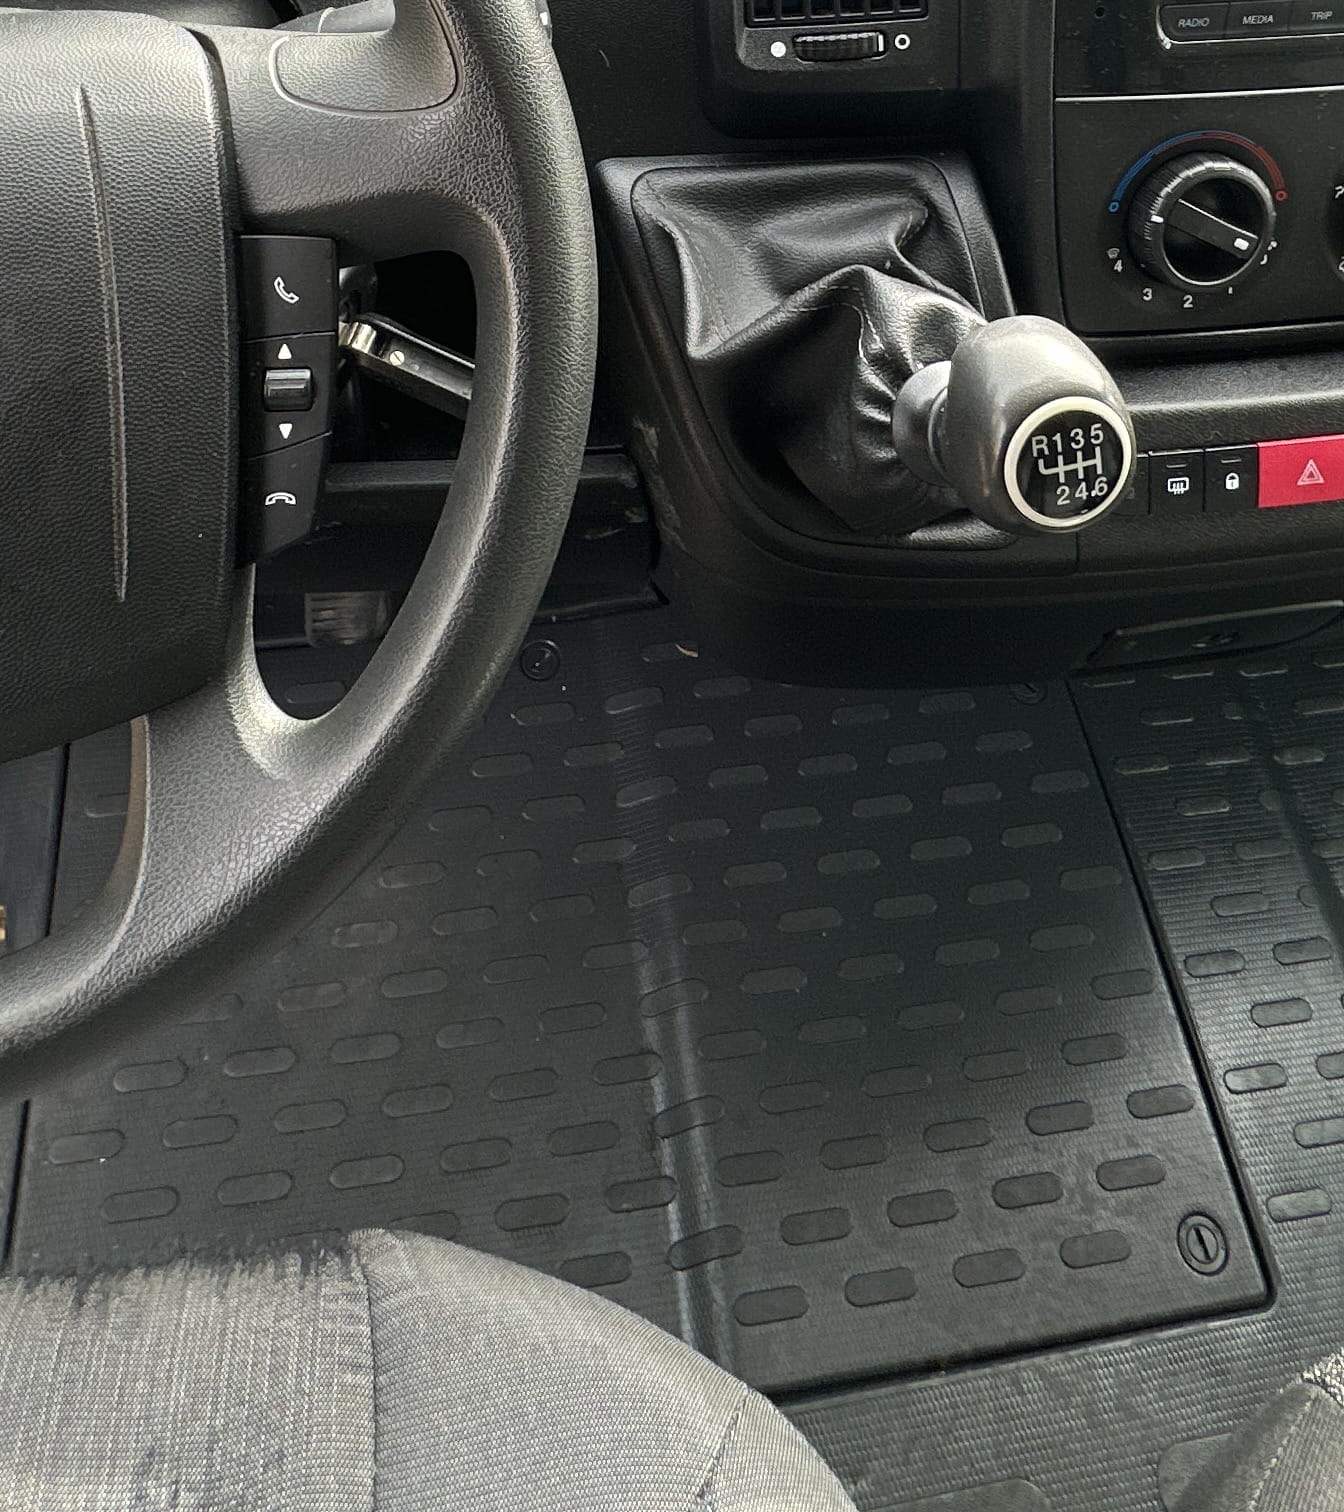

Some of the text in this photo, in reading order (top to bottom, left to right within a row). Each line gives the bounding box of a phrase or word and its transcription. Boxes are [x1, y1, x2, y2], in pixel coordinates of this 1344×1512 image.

[1242, 14, 1274, 26] MEDIA
[1311, 10, 1333, 21] TRIP
[1178, 17, 1210, 28] RADIO
[1114, 259, 1123, 273] 4
[1142, 288, 1153, 301] 3
[1183, 294, 1194, 308] 2
